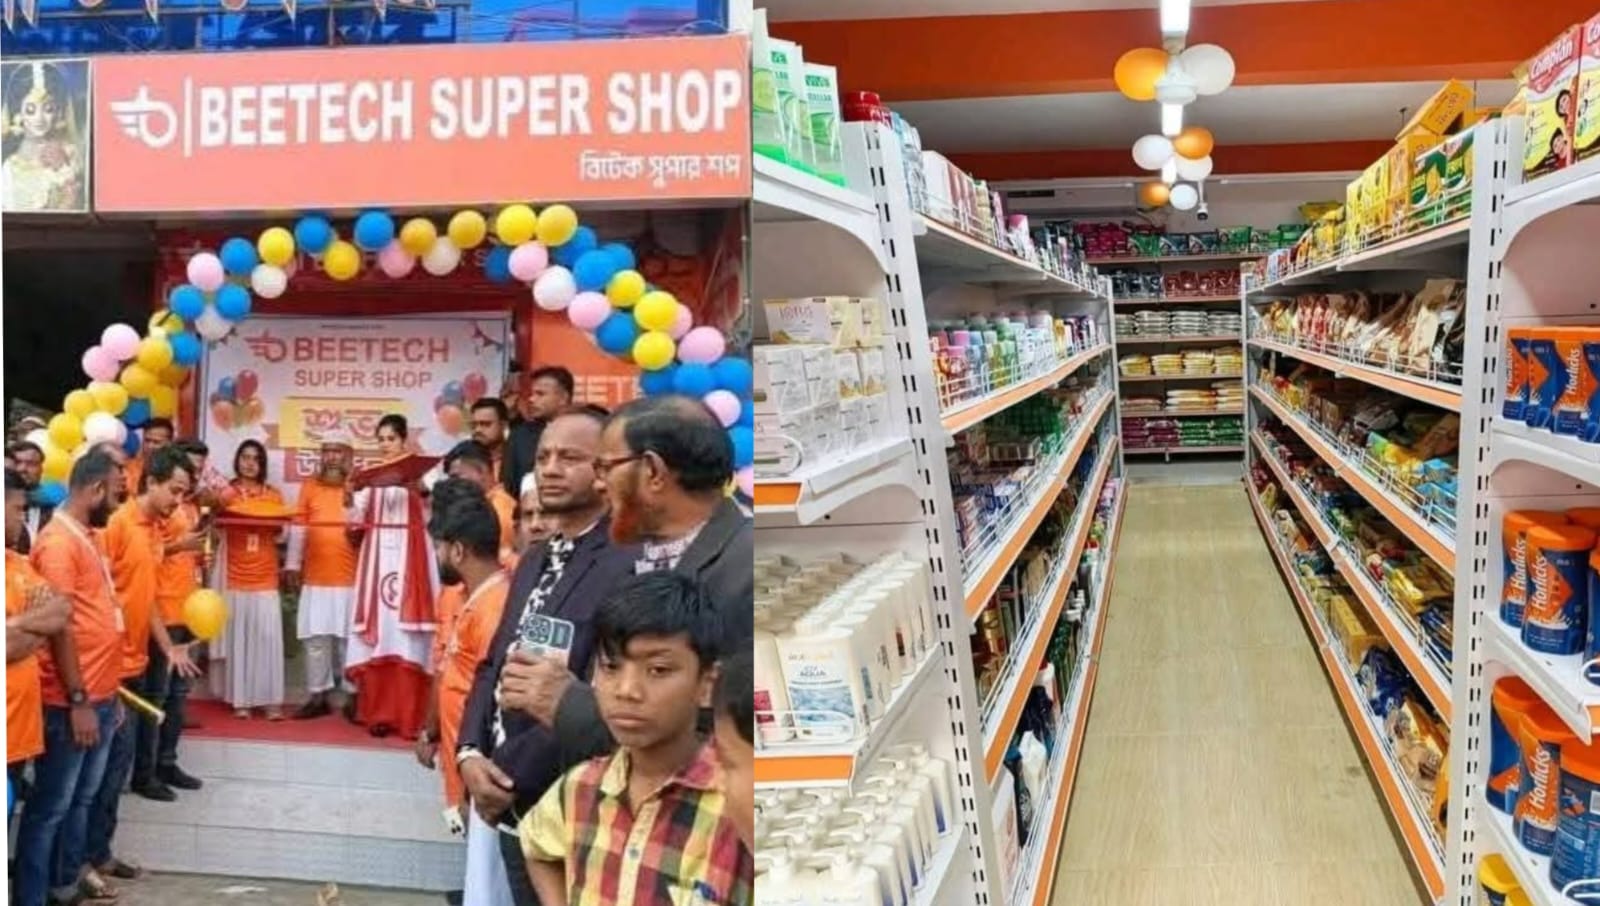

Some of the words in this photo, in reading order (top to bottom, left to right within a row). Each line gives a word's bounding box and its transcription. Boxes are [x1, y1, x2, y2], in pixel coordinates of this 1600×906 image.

[200, 79, 413, 147] BEETECH
[430, 74, 592, 139] SUPER
[607, 68, 742, 135] SHOP
[649, 155, 702, 188] সুপার
[706, 154, 742, 179] শপ
[293, 337, 449, 362] BEETECH
[1565, 347, 1580, 396] Horlicks
[295, 369, 365, 387] SUPER
[371, 370, 432, 388] SHOP
[1510, 537, 1526, 590] Horlicks
[1531, 554, 1548, 611] Horlicks
[1528, 748, 1550, 809] Horlicks
